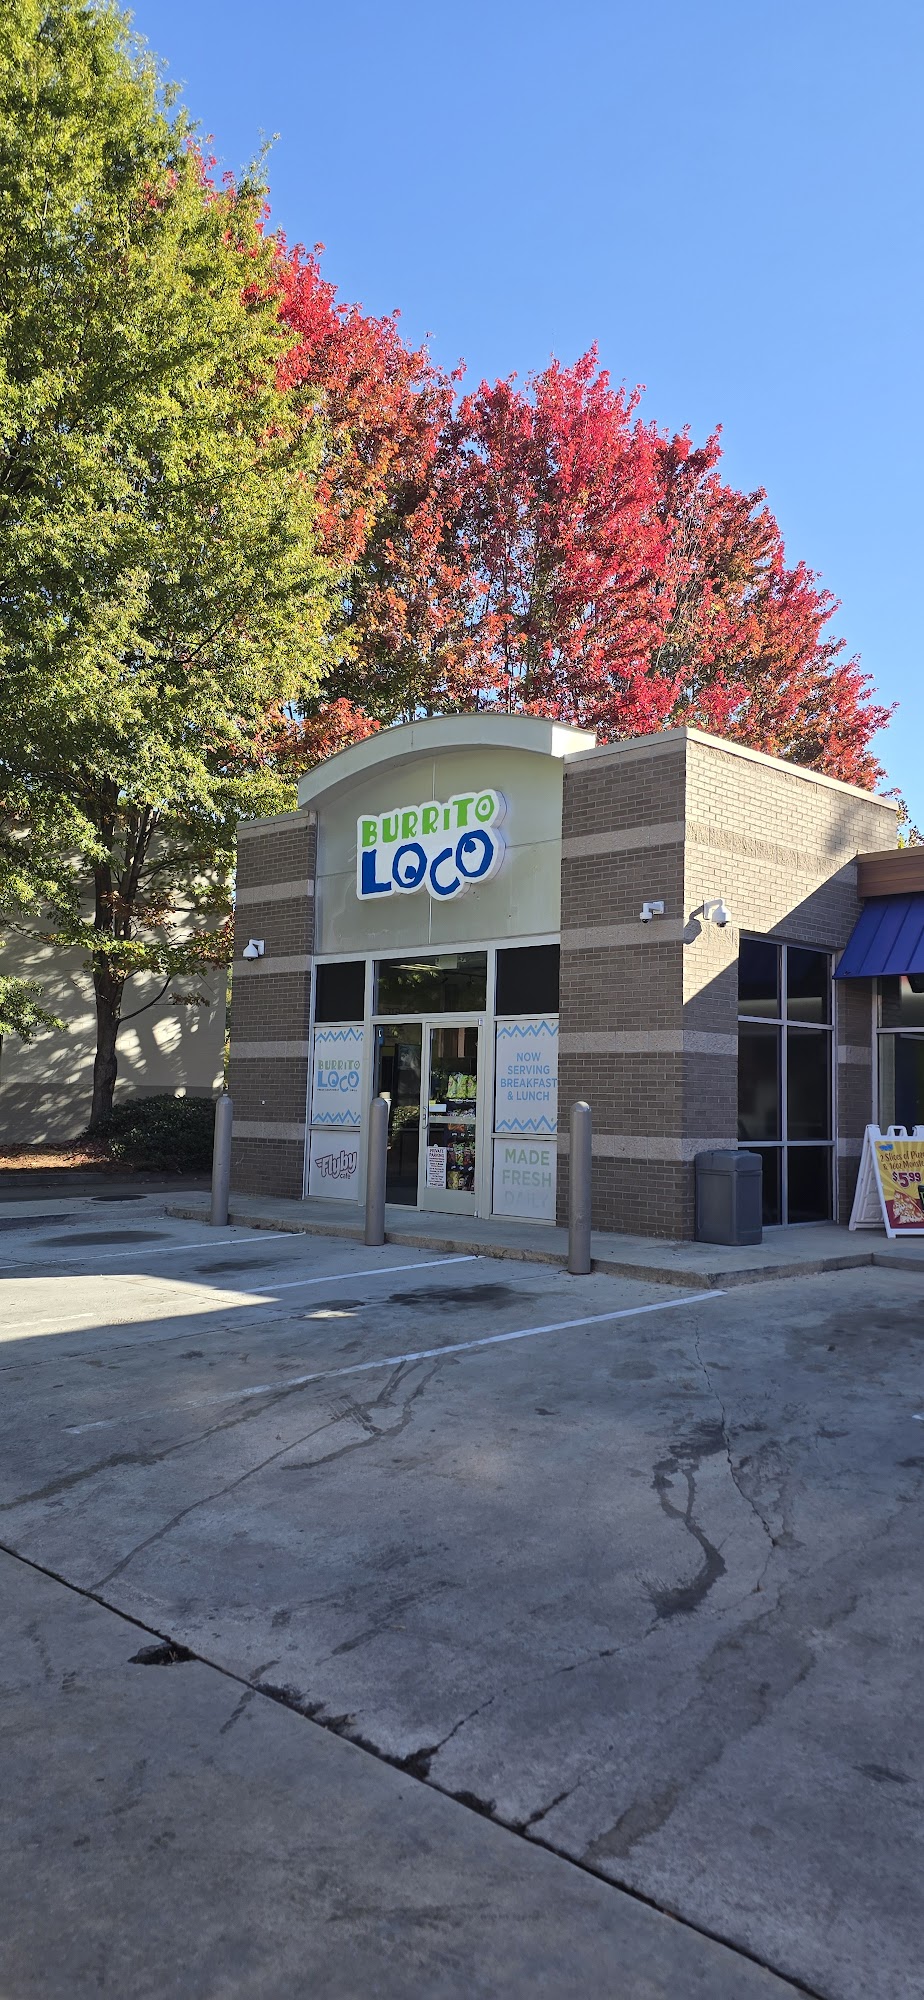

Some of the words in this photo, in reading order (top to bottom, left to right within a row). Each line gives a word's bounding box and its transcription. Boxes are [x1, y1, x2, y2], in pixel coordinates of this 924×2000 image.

[361, 794, 495, 848] BURRITO
[361, 829, 494, 896] LOCO
[516, 1052, 541, 1062] NOW
[317, 1059, 360, 1070] BURRITO
[507, 1065, 550, 1075] SERVING
[317, 1070, 360, 1093] LOCO
[500, 1078, 558, 1088] BREAKFAST
[507, 1090, 514, 1101] &
[516, 1091, 550, 1101] LUNCH
[505, 1148, 550, 1166] MADE
[880, 1154, 884, 1162] 2
[884, 1152, 903, 1162] Slices
[315, 1150, 358, 1179] Flyby
[502, 1169, 552, 1188] FRESH
